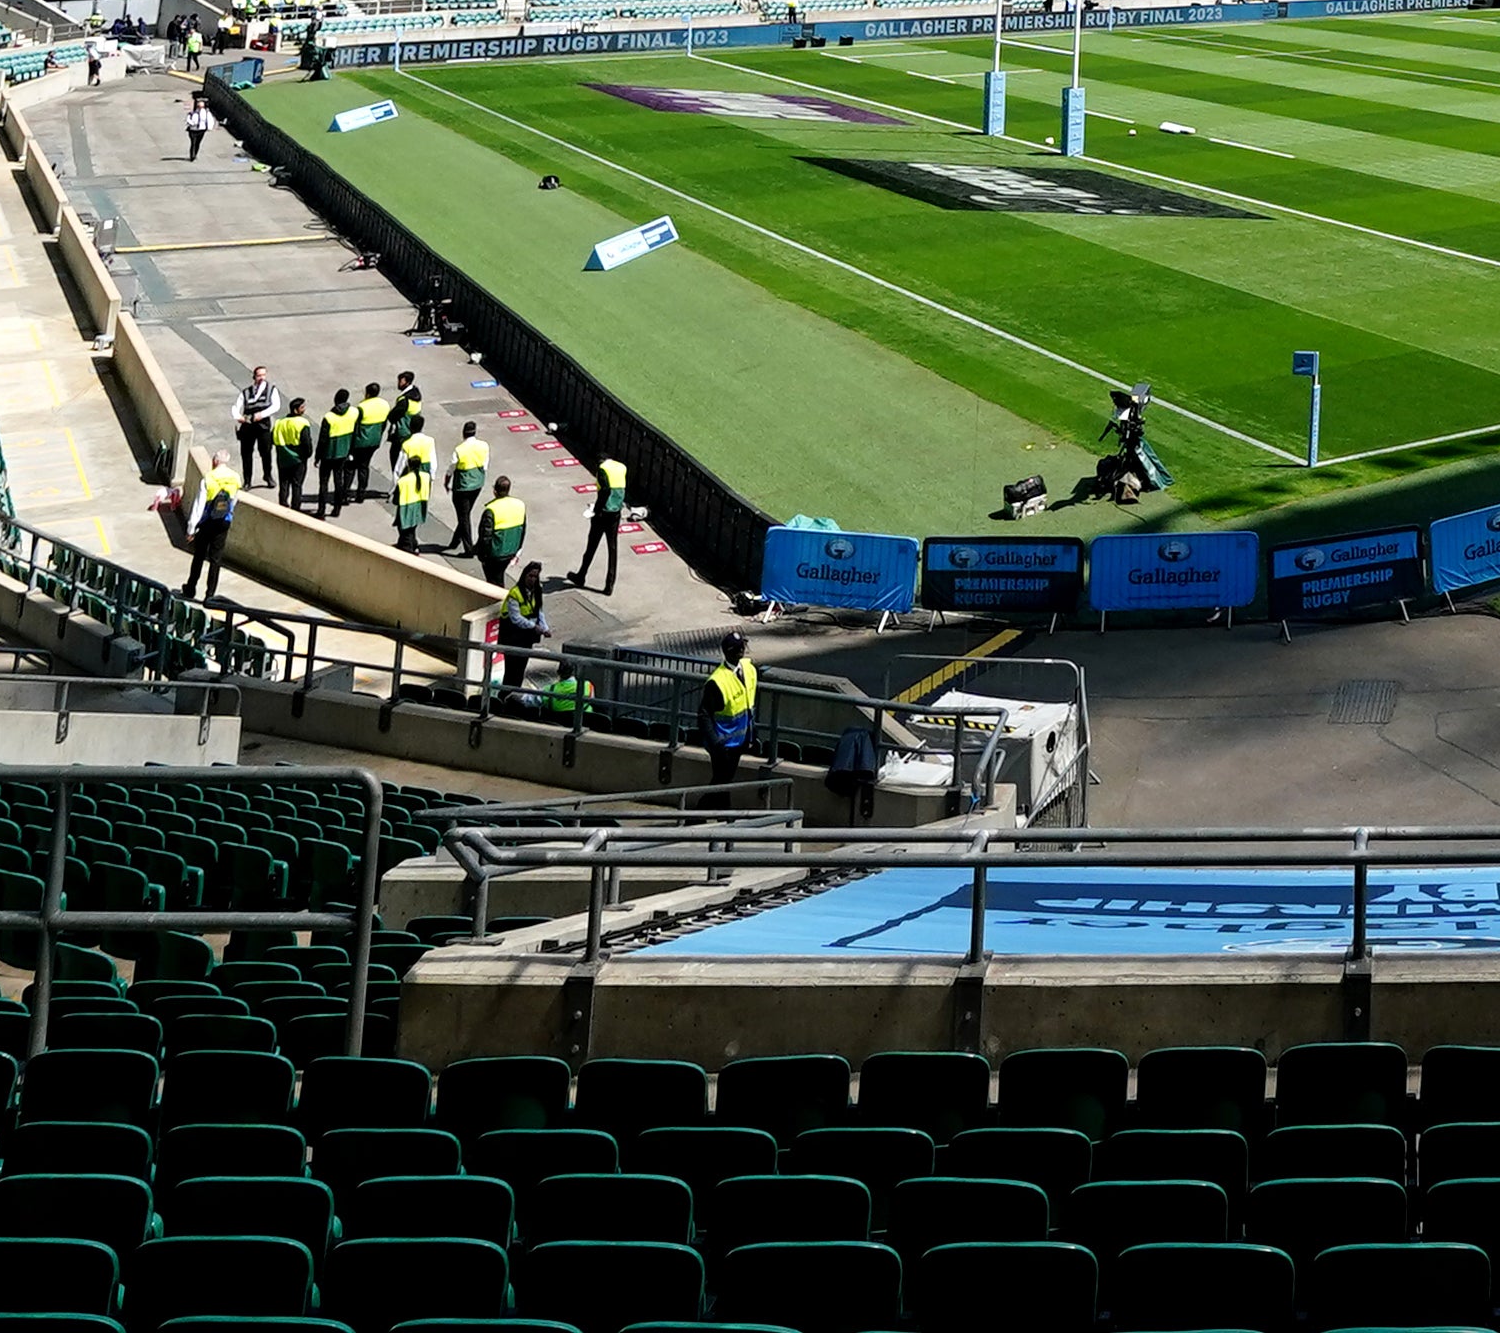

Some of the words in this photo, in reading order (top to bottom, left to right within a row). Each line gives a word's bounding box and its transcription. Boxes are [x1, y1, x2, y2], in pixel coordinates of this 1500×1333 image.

[864, 18, 967, 38] GALLAGHER
[1085, 10, 1136, 27] RUGBY
[1140, 8, 1184, 24] FINAL
[1188, 4, 1223, 21] 2023
[543, 34, 612, 53] RUGBY
[617, 32, 677, 50] FINAL
[985, 550, 1058, 568] Gallagher
[1330, 541, 1400, 564] Gallagher
[796, 563, 881, 585] Gallagher
[1128, 566, 1221, 587] Gallagher
[1302, 567, 1394, 595] PREMIERSHIP
[954, 578, 1050, 592] PREMIERSHIP
[954, 592, 1002, 606] RUGBY
[1302, 589, 1351, 610] RUGBY
